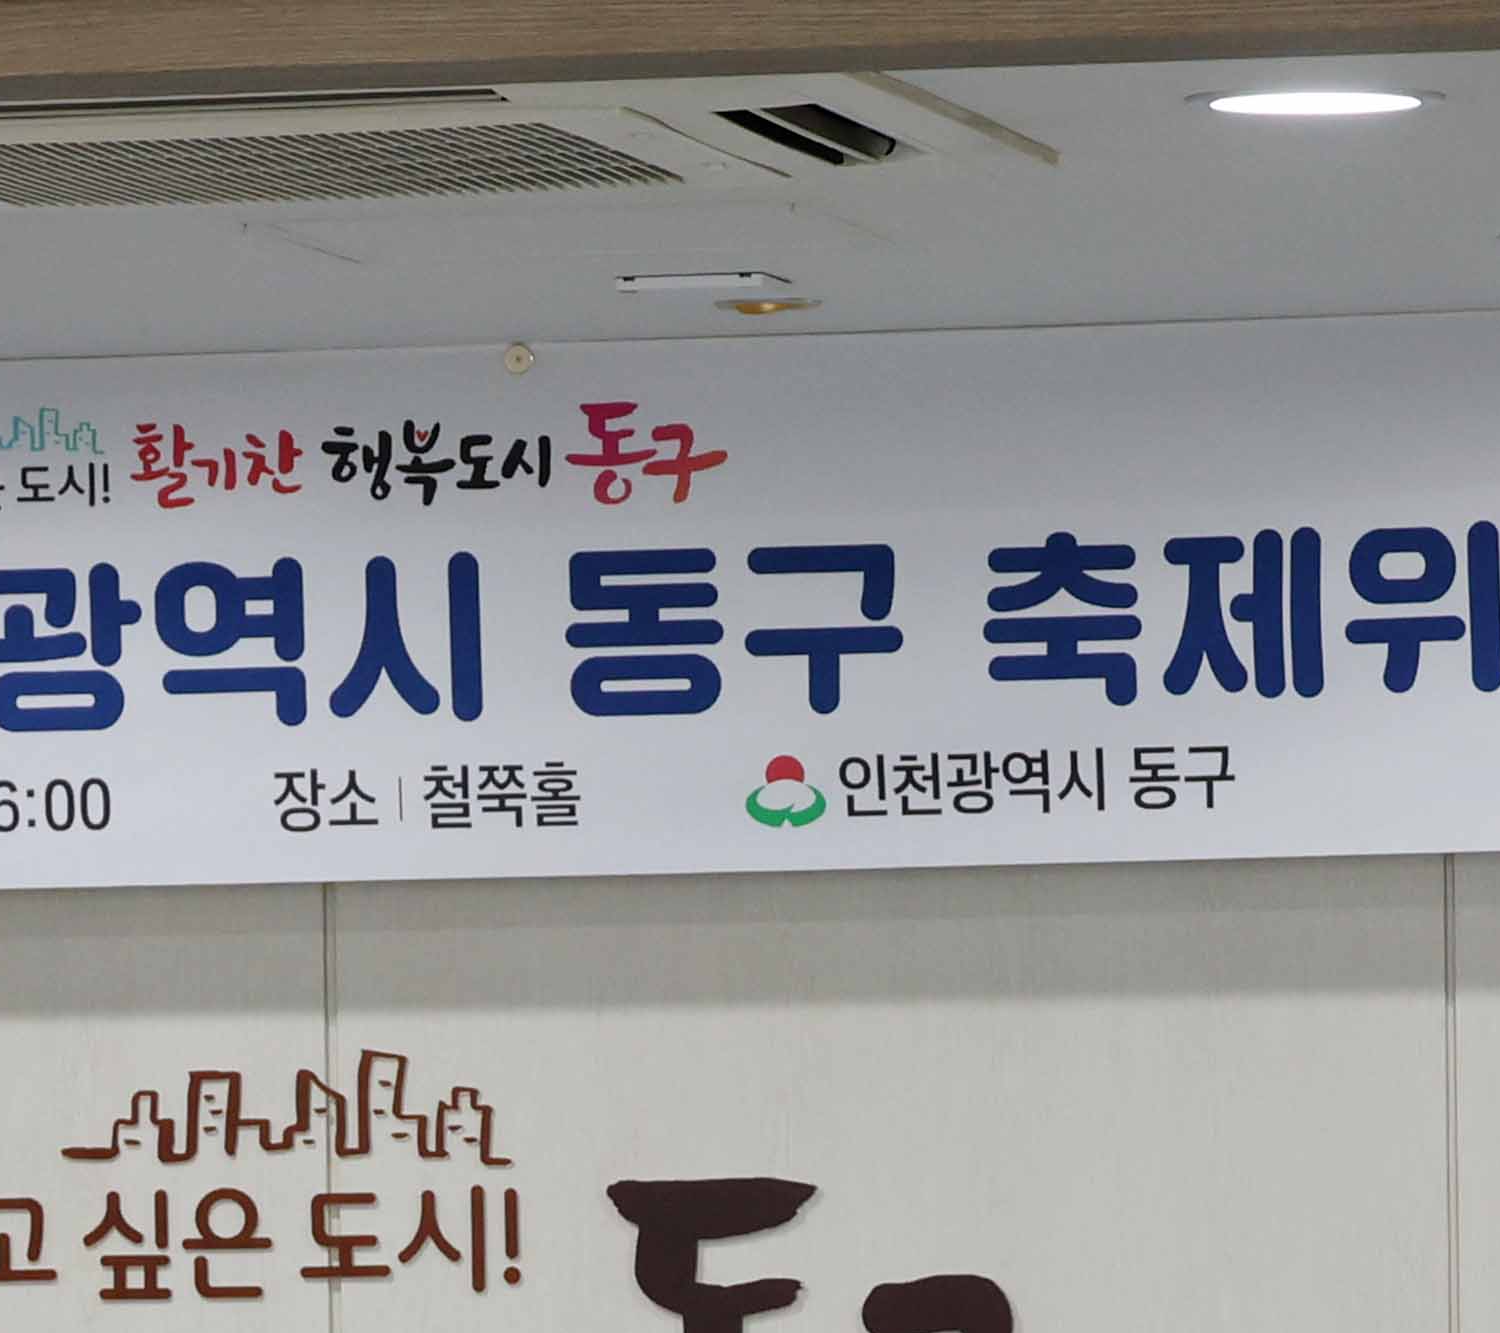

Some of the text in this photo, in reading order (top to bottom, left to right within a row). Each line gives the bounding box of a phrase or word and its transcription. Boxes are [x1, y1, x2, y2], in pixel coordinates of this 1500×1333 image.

[17, 462, 111, 507] 도시!
[131, 423, 303, 509] 활기찬
[321, 420, 551, 507] 행복도시
[565, 401, 727, 505] 동구
[565, 543, 904, 717] 동구
[273, 761, 582, 833] 장소 철쭉홀
[838, 745, 1236, 818] 인천광역시 동구
[82, 1188, 274, 1303] 싶은
[300, 1184, 522, 1296] 도시!
